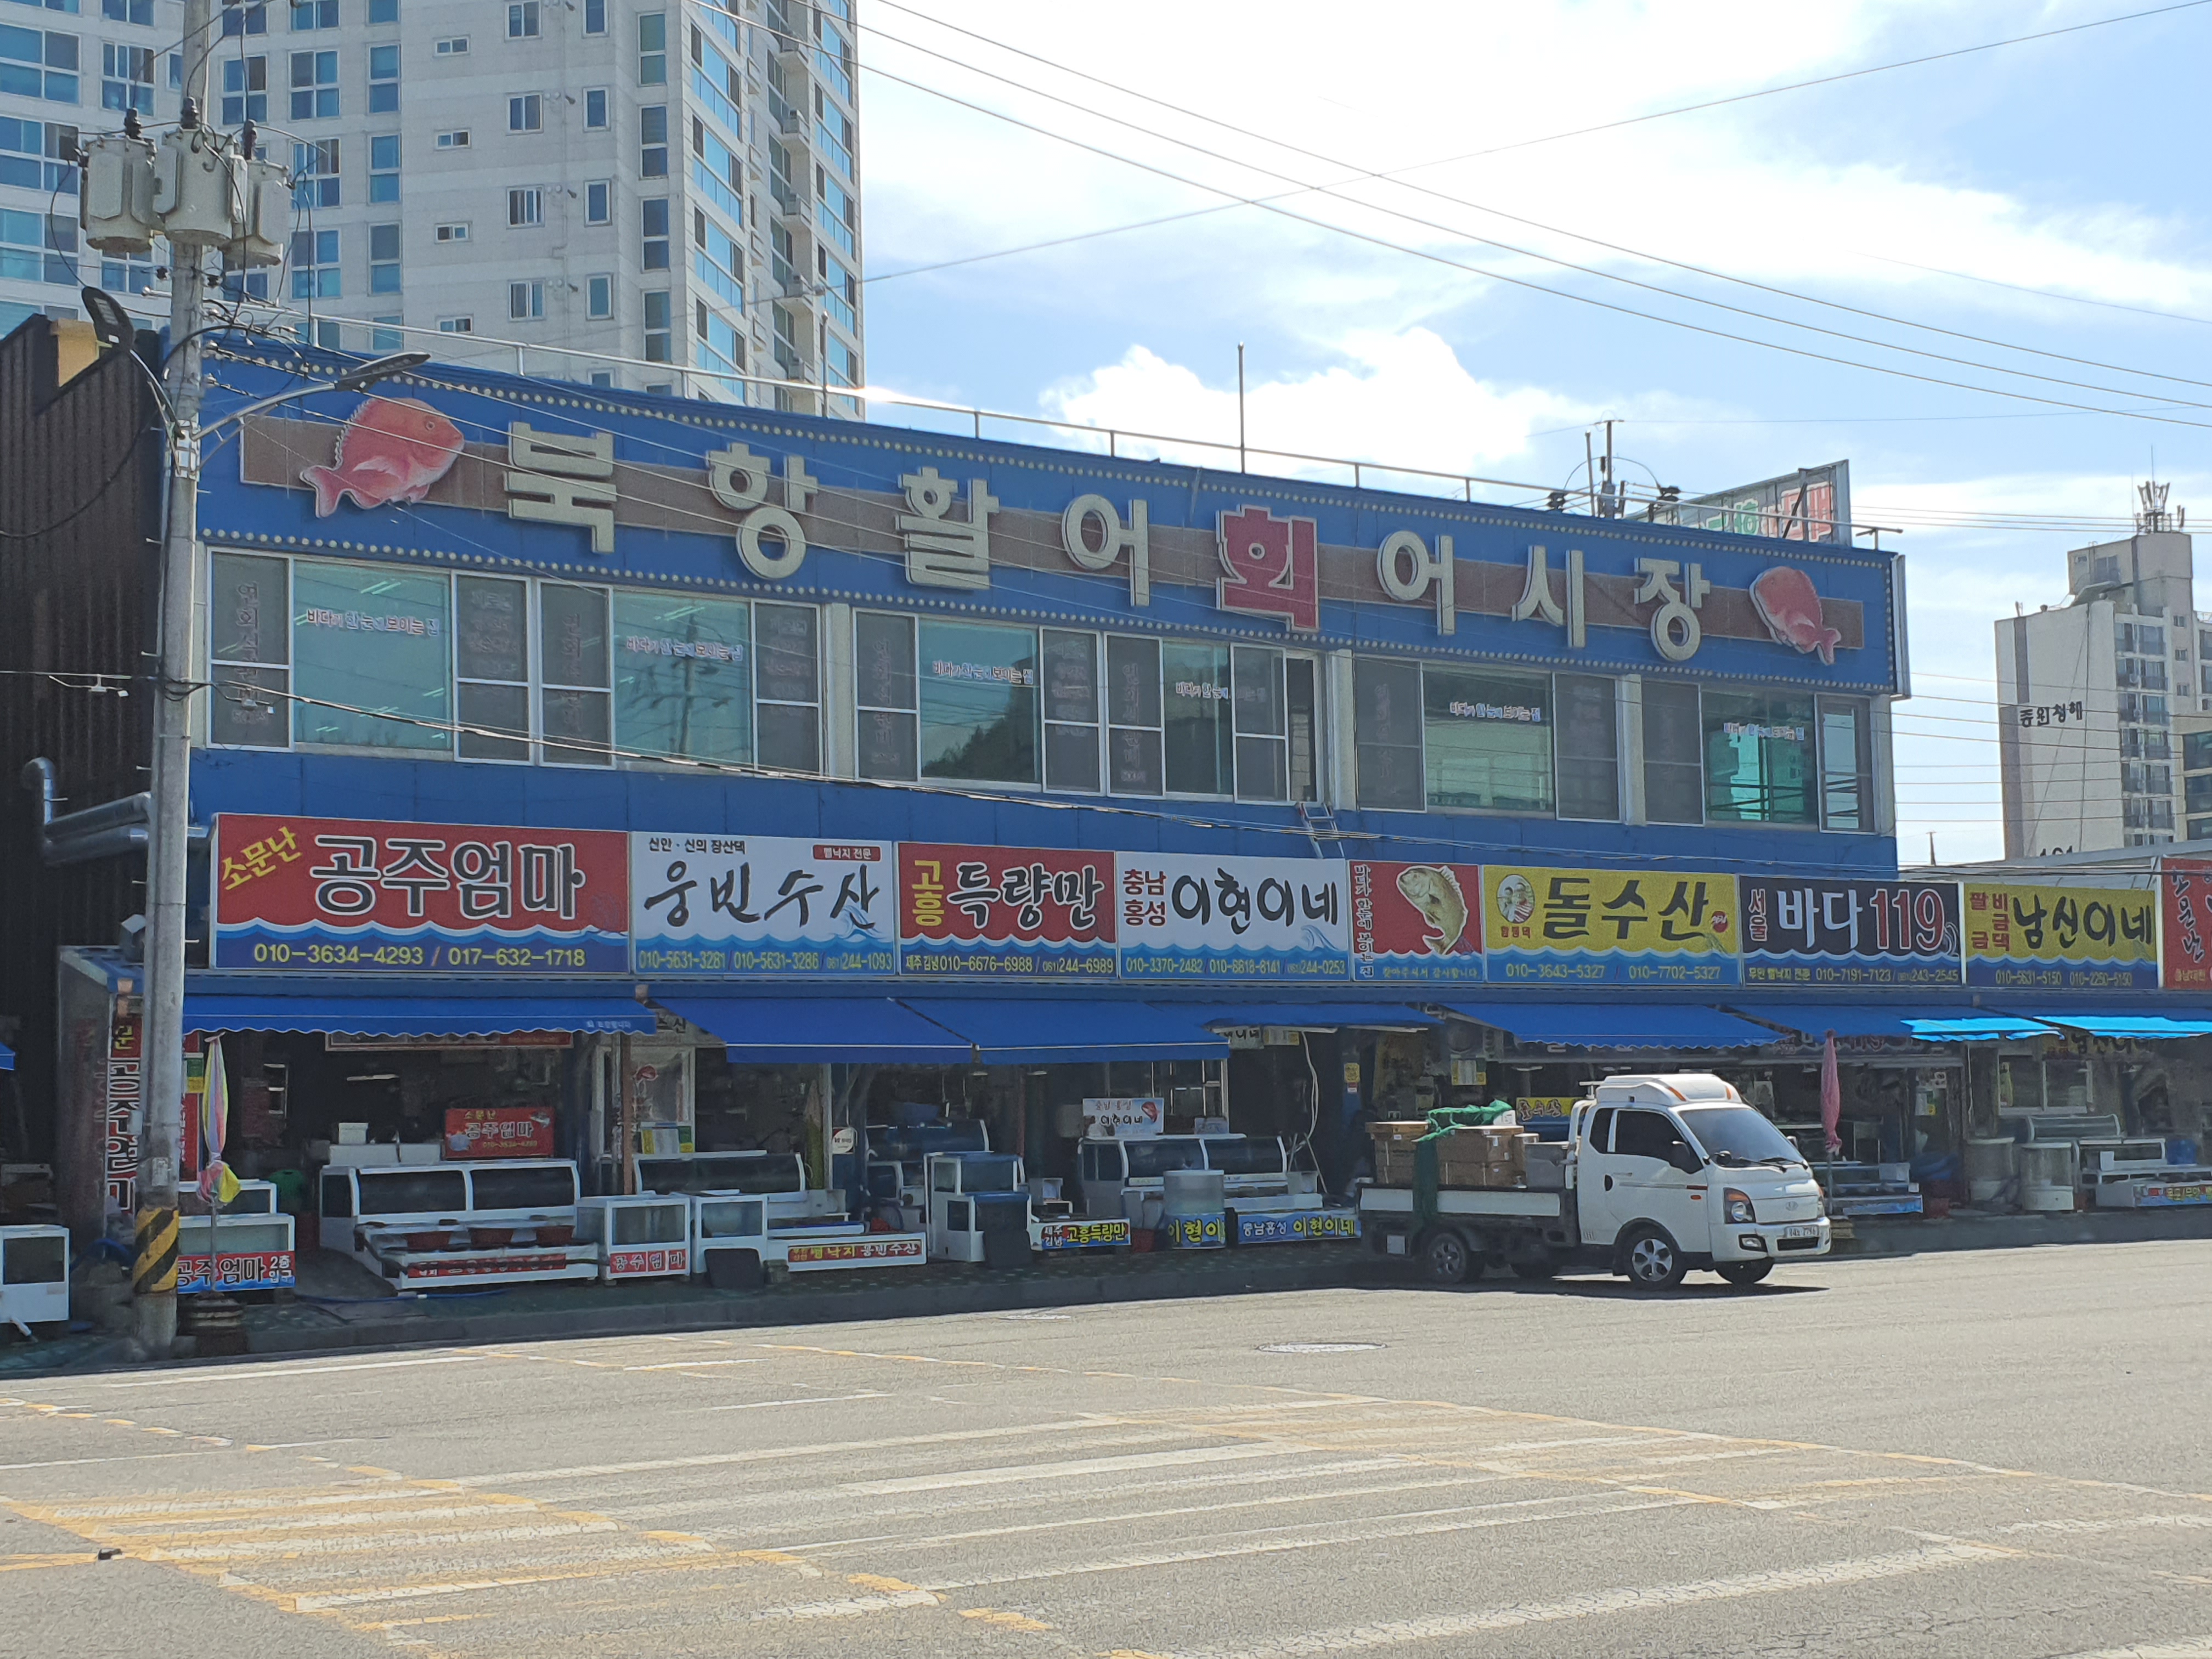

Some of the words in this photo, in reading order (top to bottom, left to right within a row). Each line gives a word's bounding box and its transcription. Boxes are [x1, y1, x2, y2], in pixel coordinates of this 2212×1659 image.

[222, 826, 303, 890] 소문난
[649, 838, 673, 852] 신안
[685, 839, 707, 853] 신의
[309, 833, 586, 919] 공주엄마
[644, 860, 881, 930] 웅빈수산
[911, 859, 944, 927] 고흥
[947, 862, 1104, 933] 득량만
[1122, 870, 1166, 896] 충남
[1171, 867, 1339, 935] 이현이네
[1122, 899, 1166, 927] 홍성
[1543, 877, 1709, 941] 돌수산
[1748, 888, 1768, 942] 서울
[2013, 893, 2152, 950] 남신이네
[253, 943, 424, 967] 010-3634-4293
[448, 946, 586, 968] 017-632-1718
[940, 955, 1032, 972] 010-6676-6988
[1293, 1216, 1356, 1238] 이현이네
